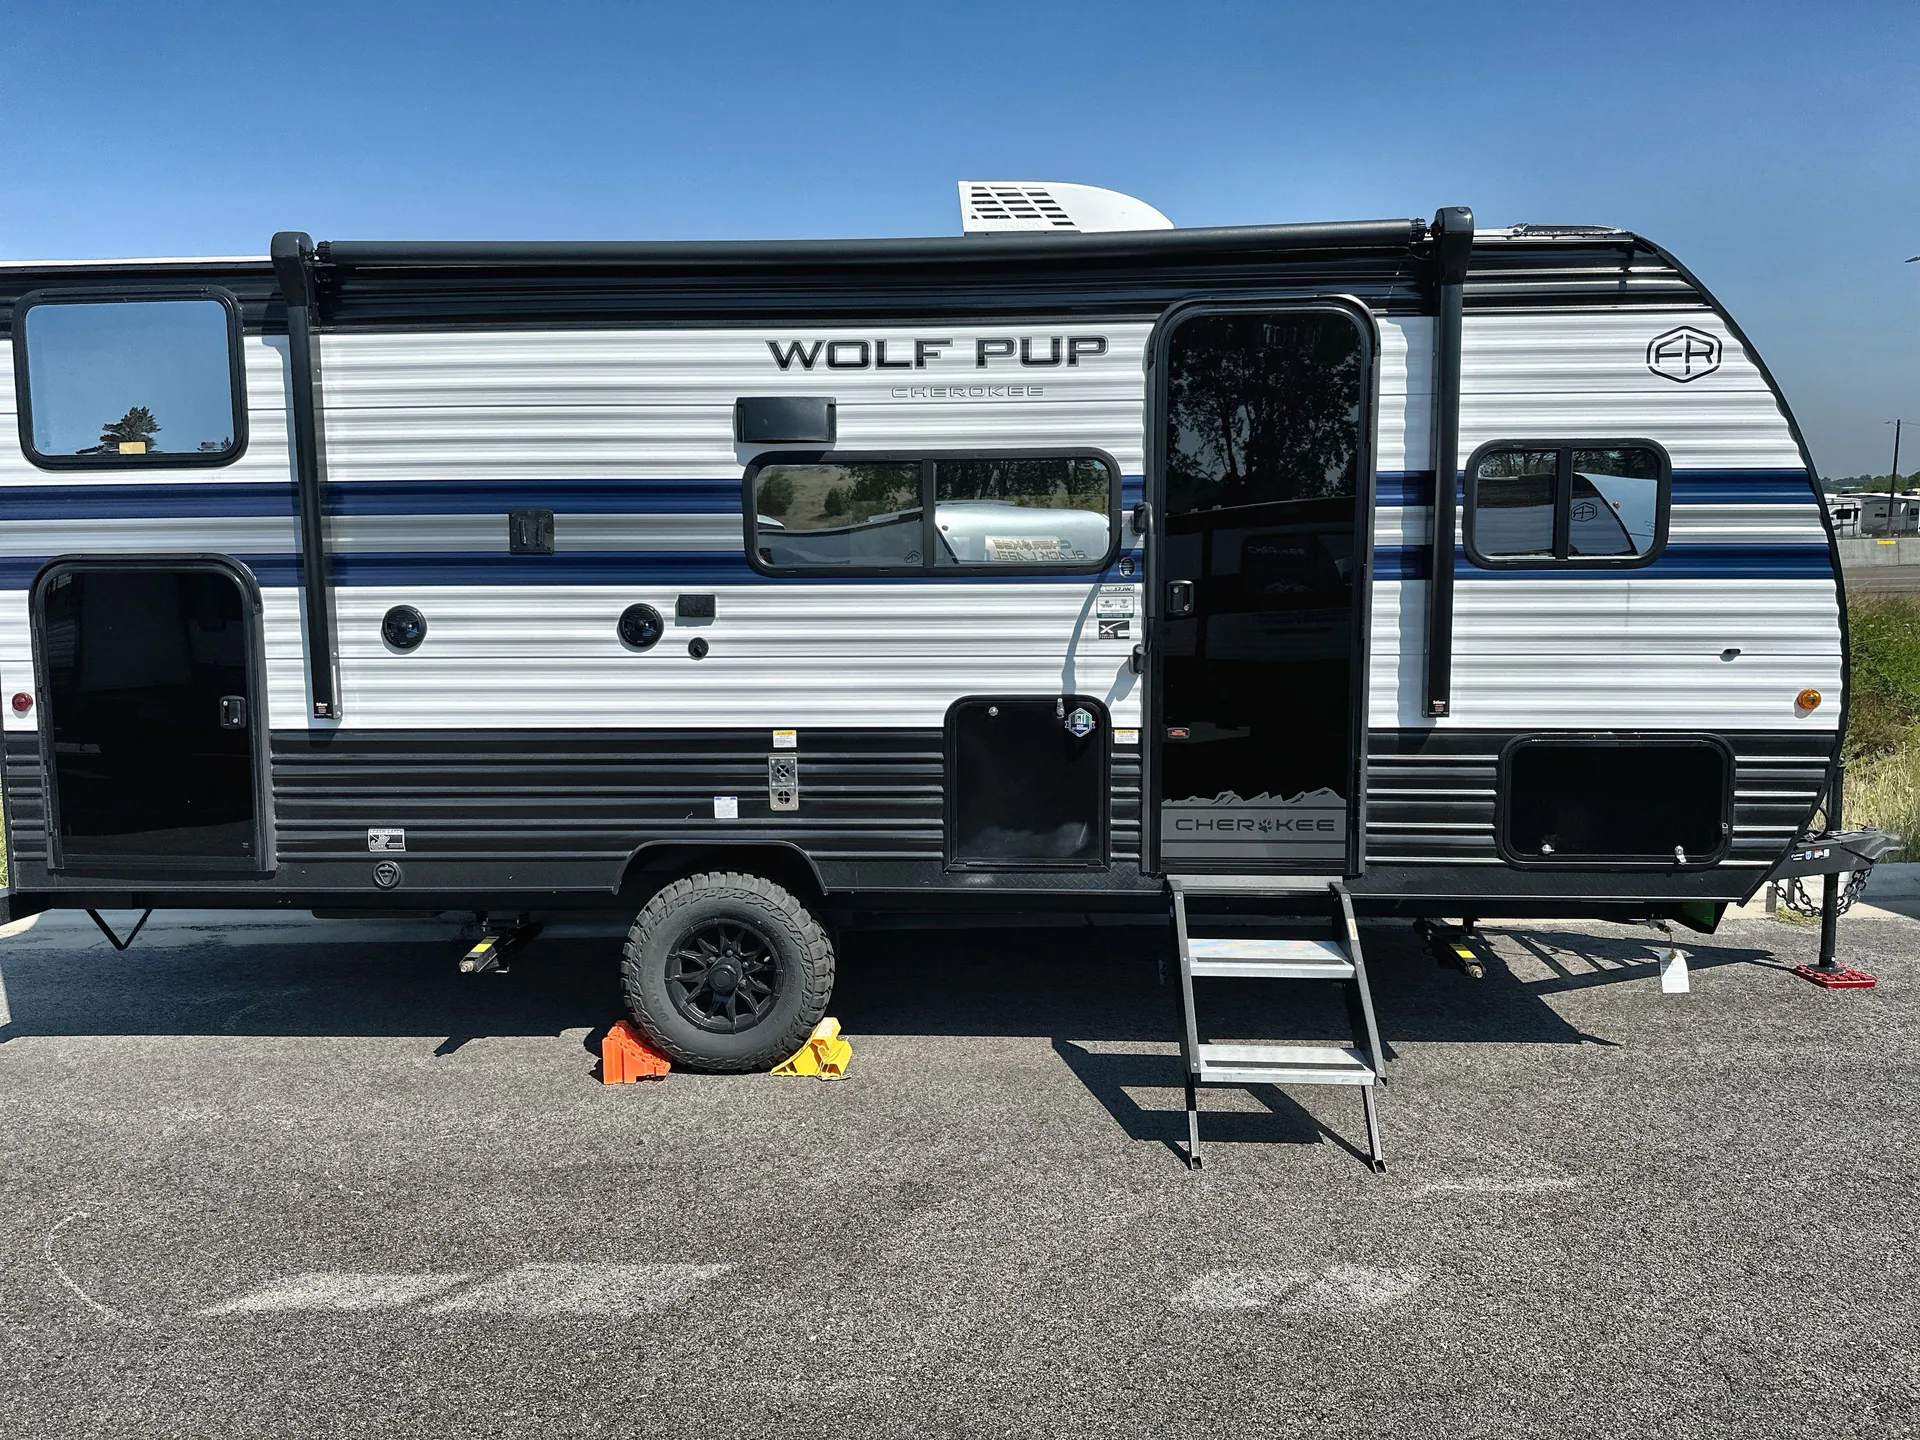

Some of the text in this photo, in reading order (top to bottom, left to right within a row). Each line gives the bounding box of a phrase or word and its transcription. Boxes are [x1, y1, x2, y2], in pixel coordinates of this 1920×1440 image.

[765, 336, 1109, 371] WOLF PUP
[891, 386, 1044, 398] CHEROKEE
